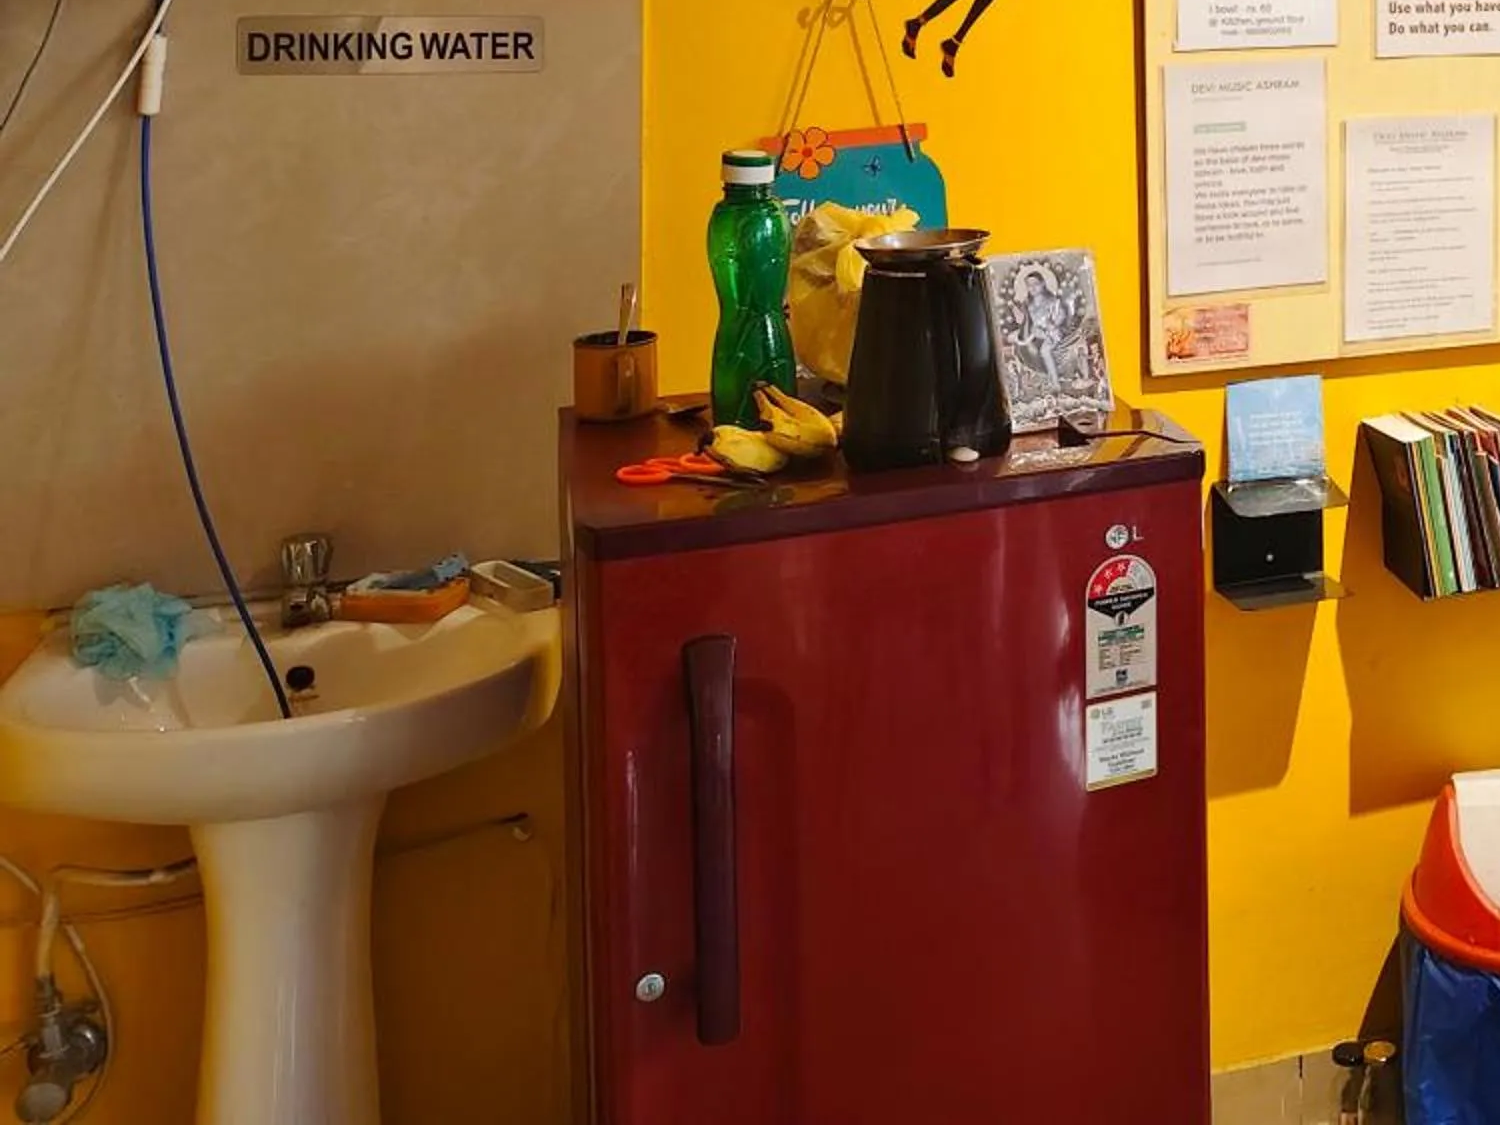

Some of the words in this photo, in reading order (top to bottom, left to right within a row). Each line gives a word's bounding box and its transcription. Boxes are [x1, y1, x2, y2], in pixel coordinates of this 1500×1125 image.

[1388, 1, 1411, 15] Use
[1414, 0, 1446, 14] what
[1449, 1, 1472, 16] you
[1388, 21, 1405, 35] Do
[1408, 21, 1440, 35] what
[1442, 22, 1466, 38] you
[247, 31, 414, 62] DRINKING
[419, 31, 535, 61] WATER
